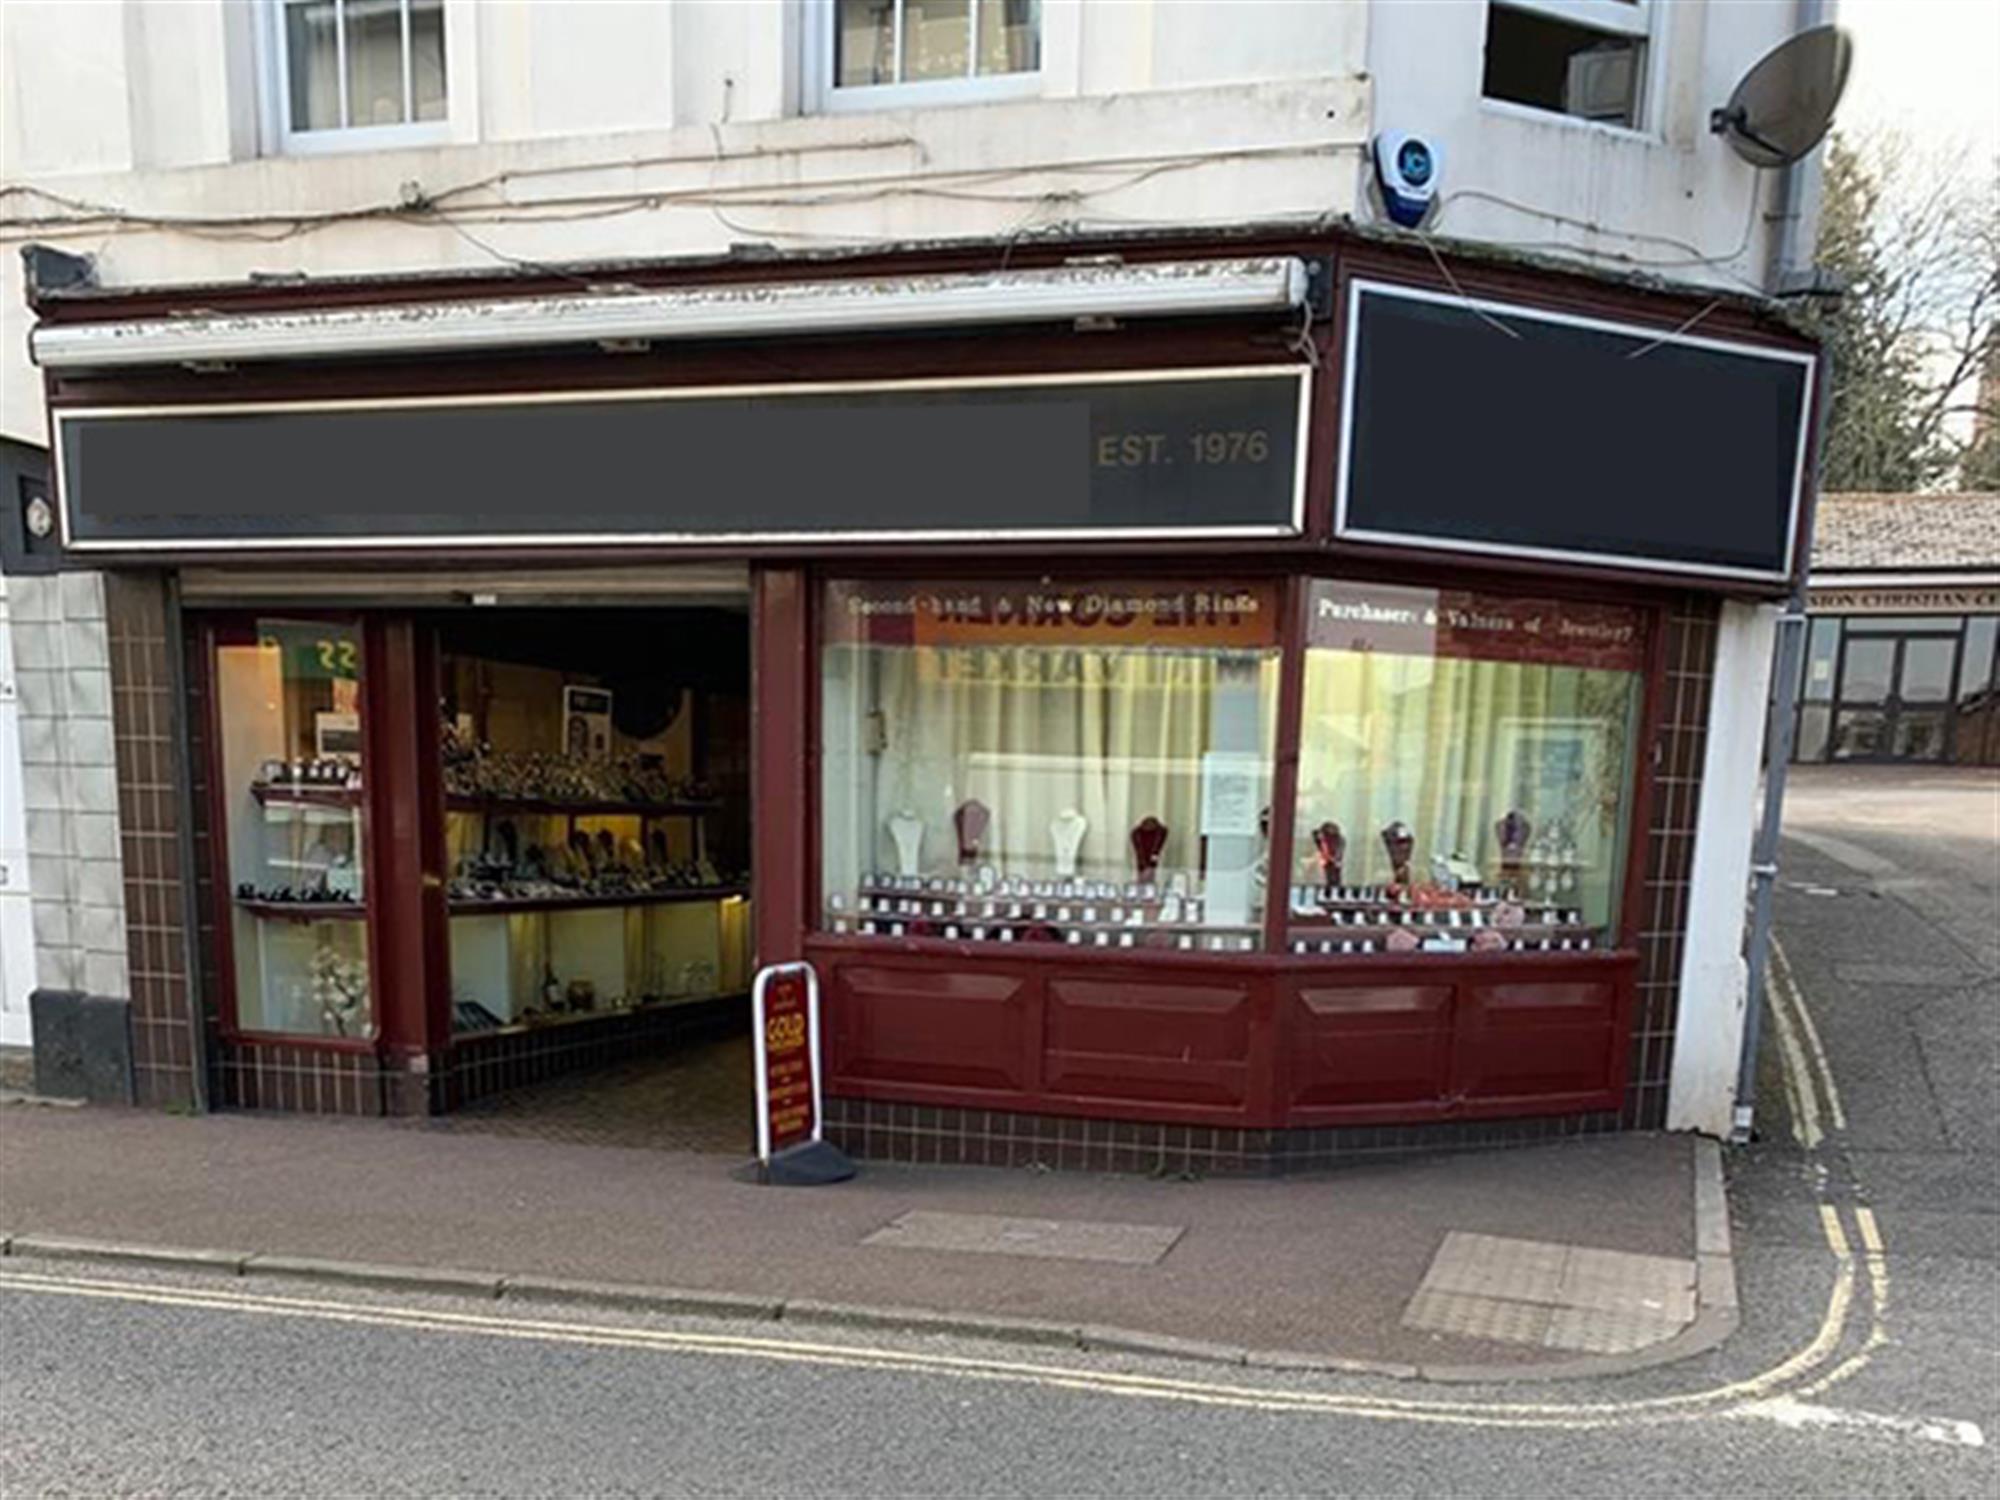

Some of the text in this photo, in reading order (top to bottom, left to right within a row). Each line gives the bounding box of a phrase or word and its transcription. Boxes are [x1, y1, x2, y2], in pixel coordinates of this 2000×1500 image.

[1097, 430, 1269, 467] EST. 1976
[1861, 590, 1968, 608] CHRISTIAN
